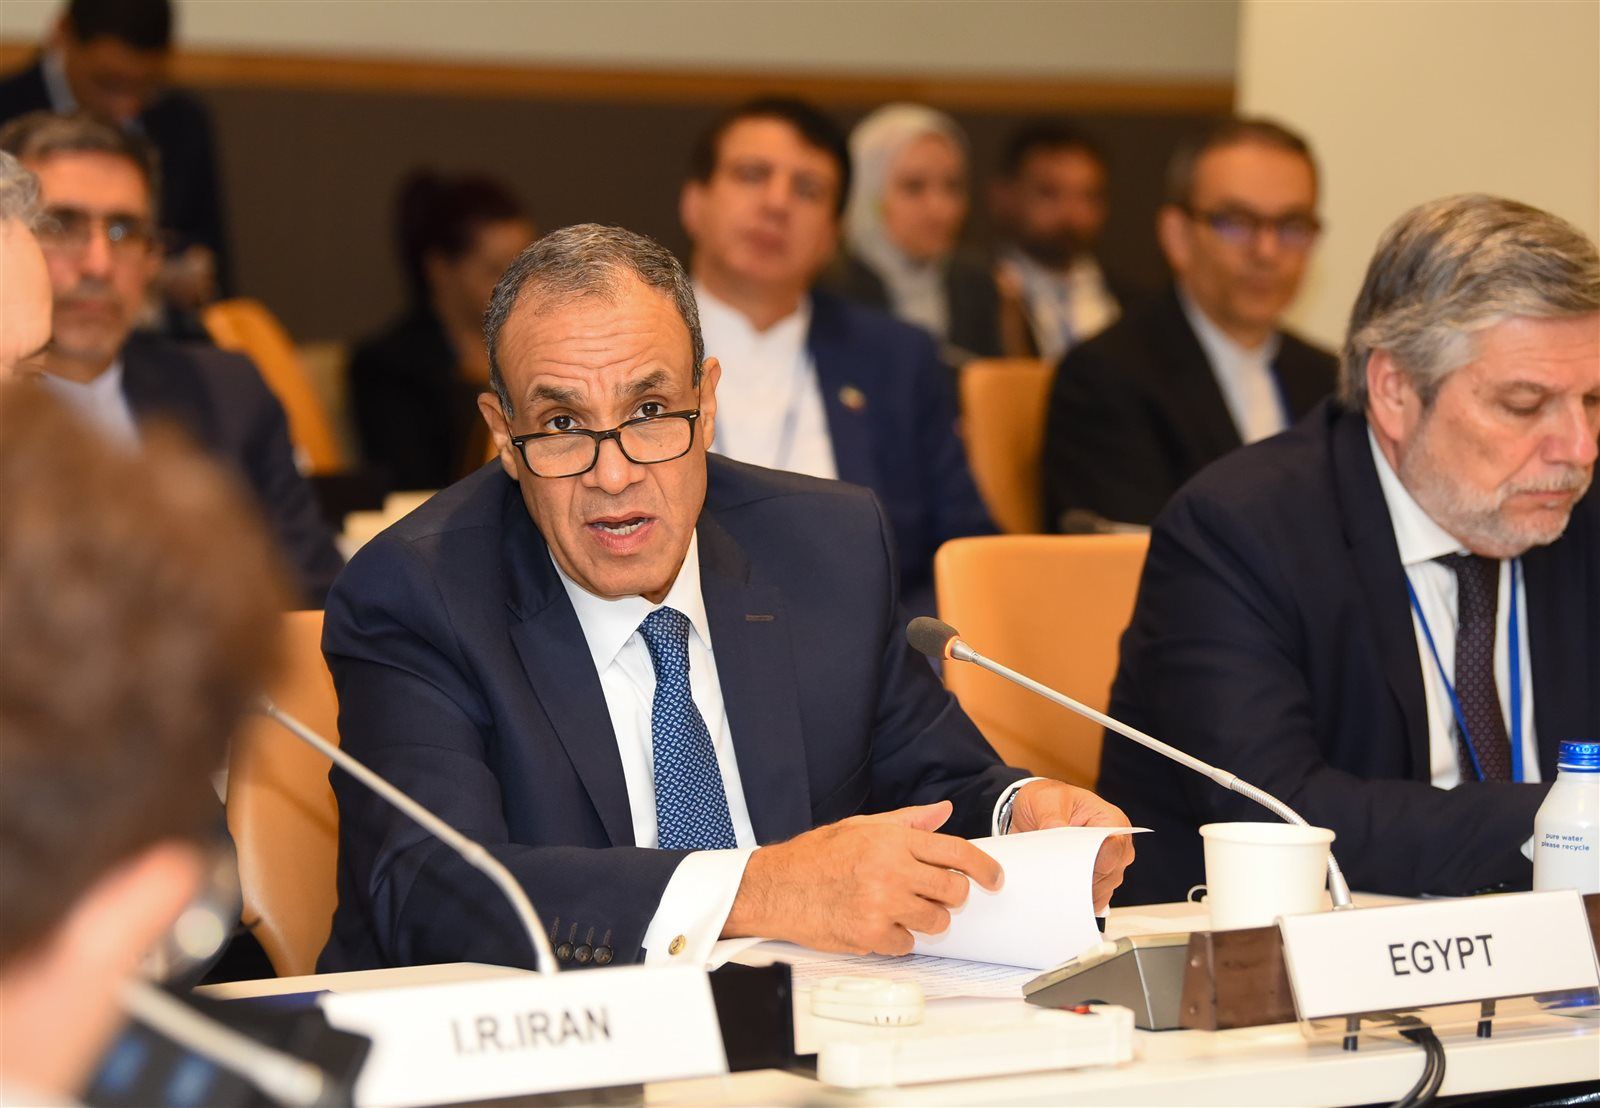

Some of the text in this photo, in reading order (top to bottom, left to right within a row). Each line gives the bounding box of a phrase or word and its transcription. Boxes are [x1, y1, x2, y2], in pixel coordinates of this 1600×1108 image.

[1545, 833, 1584, 842] pure water
[1541, 841, 1590, 852] please recycle
[1388, 934, 1493, 976] EGYPT
